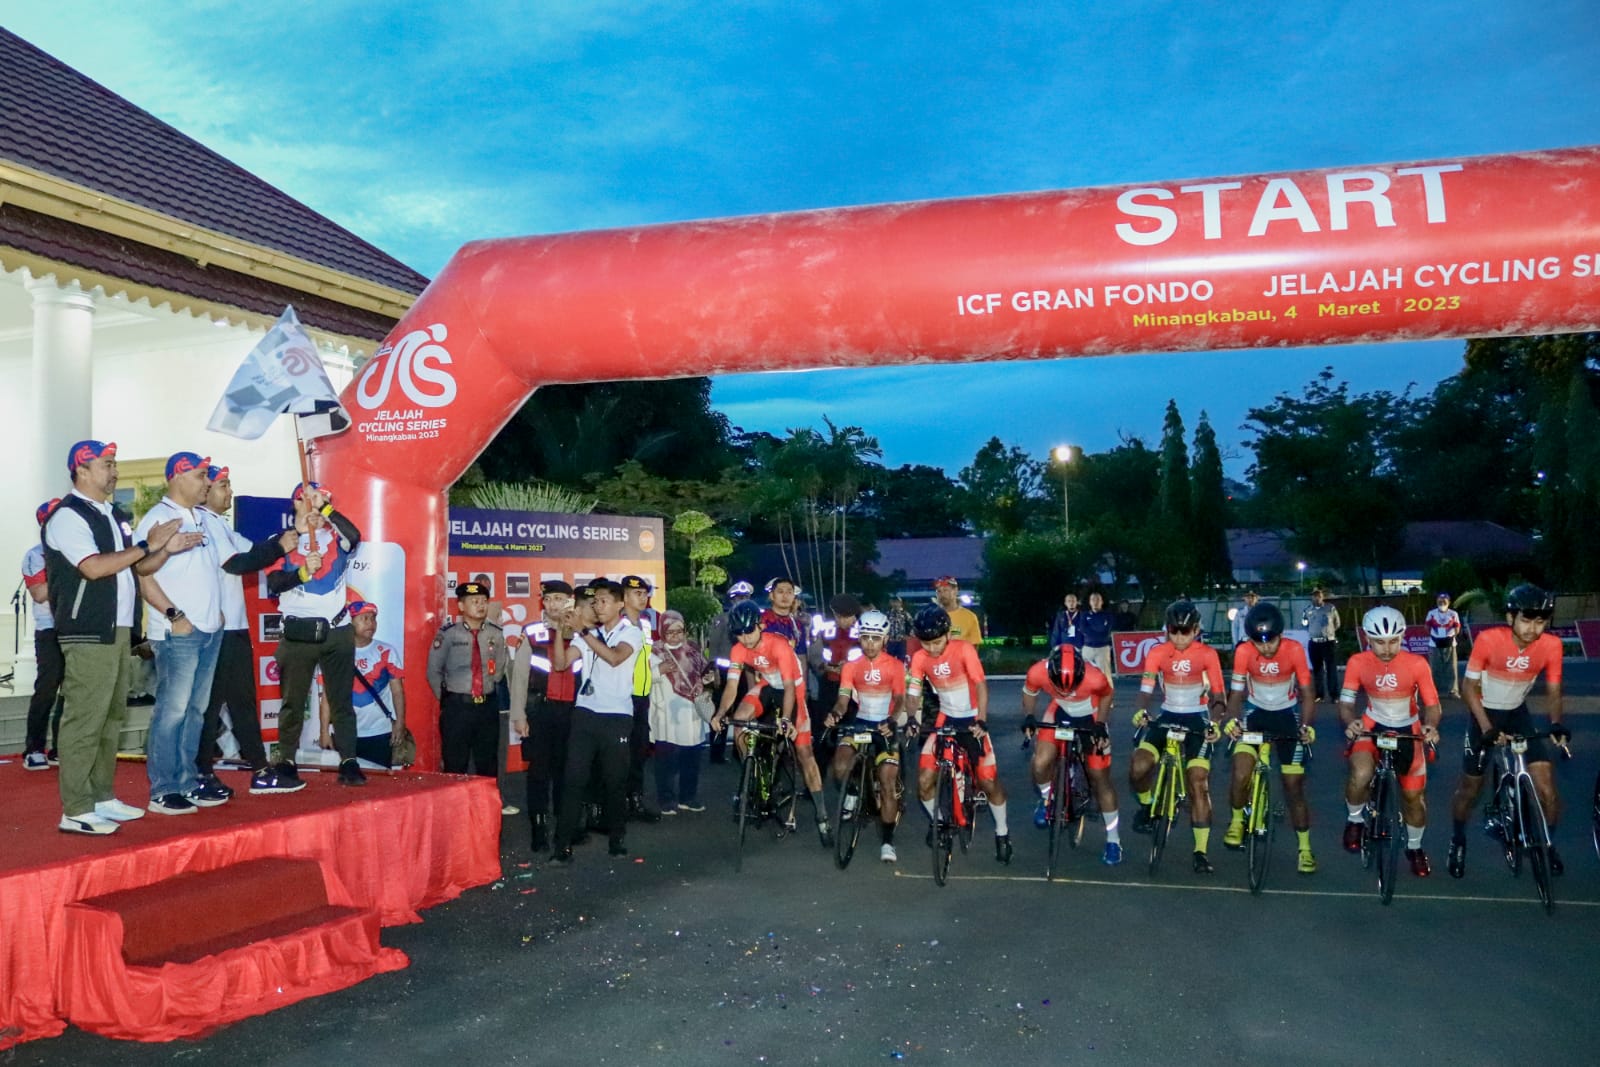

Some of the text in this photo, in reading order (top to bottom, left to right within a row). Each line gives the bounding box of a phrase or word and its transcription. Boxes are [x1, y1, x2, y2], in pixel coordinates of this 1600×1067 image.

[1114, 164, 1463, 246] START
[957, 293, 1001, 316] ICF
[1011, 287, 1094, 312] GRAN
[1104, 279, 1214, 307] FONDO
[1263, 267, 1402, 297] JELAJAH
[1414, 257, 1561, 287] CYCLING
[1133, 295, 1461, 328] Minangkabau, 4 Maret 2023
[373, 409, 424, 421] JELAJAH
[358, 418, 447, 433] CYCLING SERIES
[366, 430, 440, 443] Minangkabau 2023
[516, 522, 580, 541] CYCLING
[582, 525, 630, 542] SERIES
